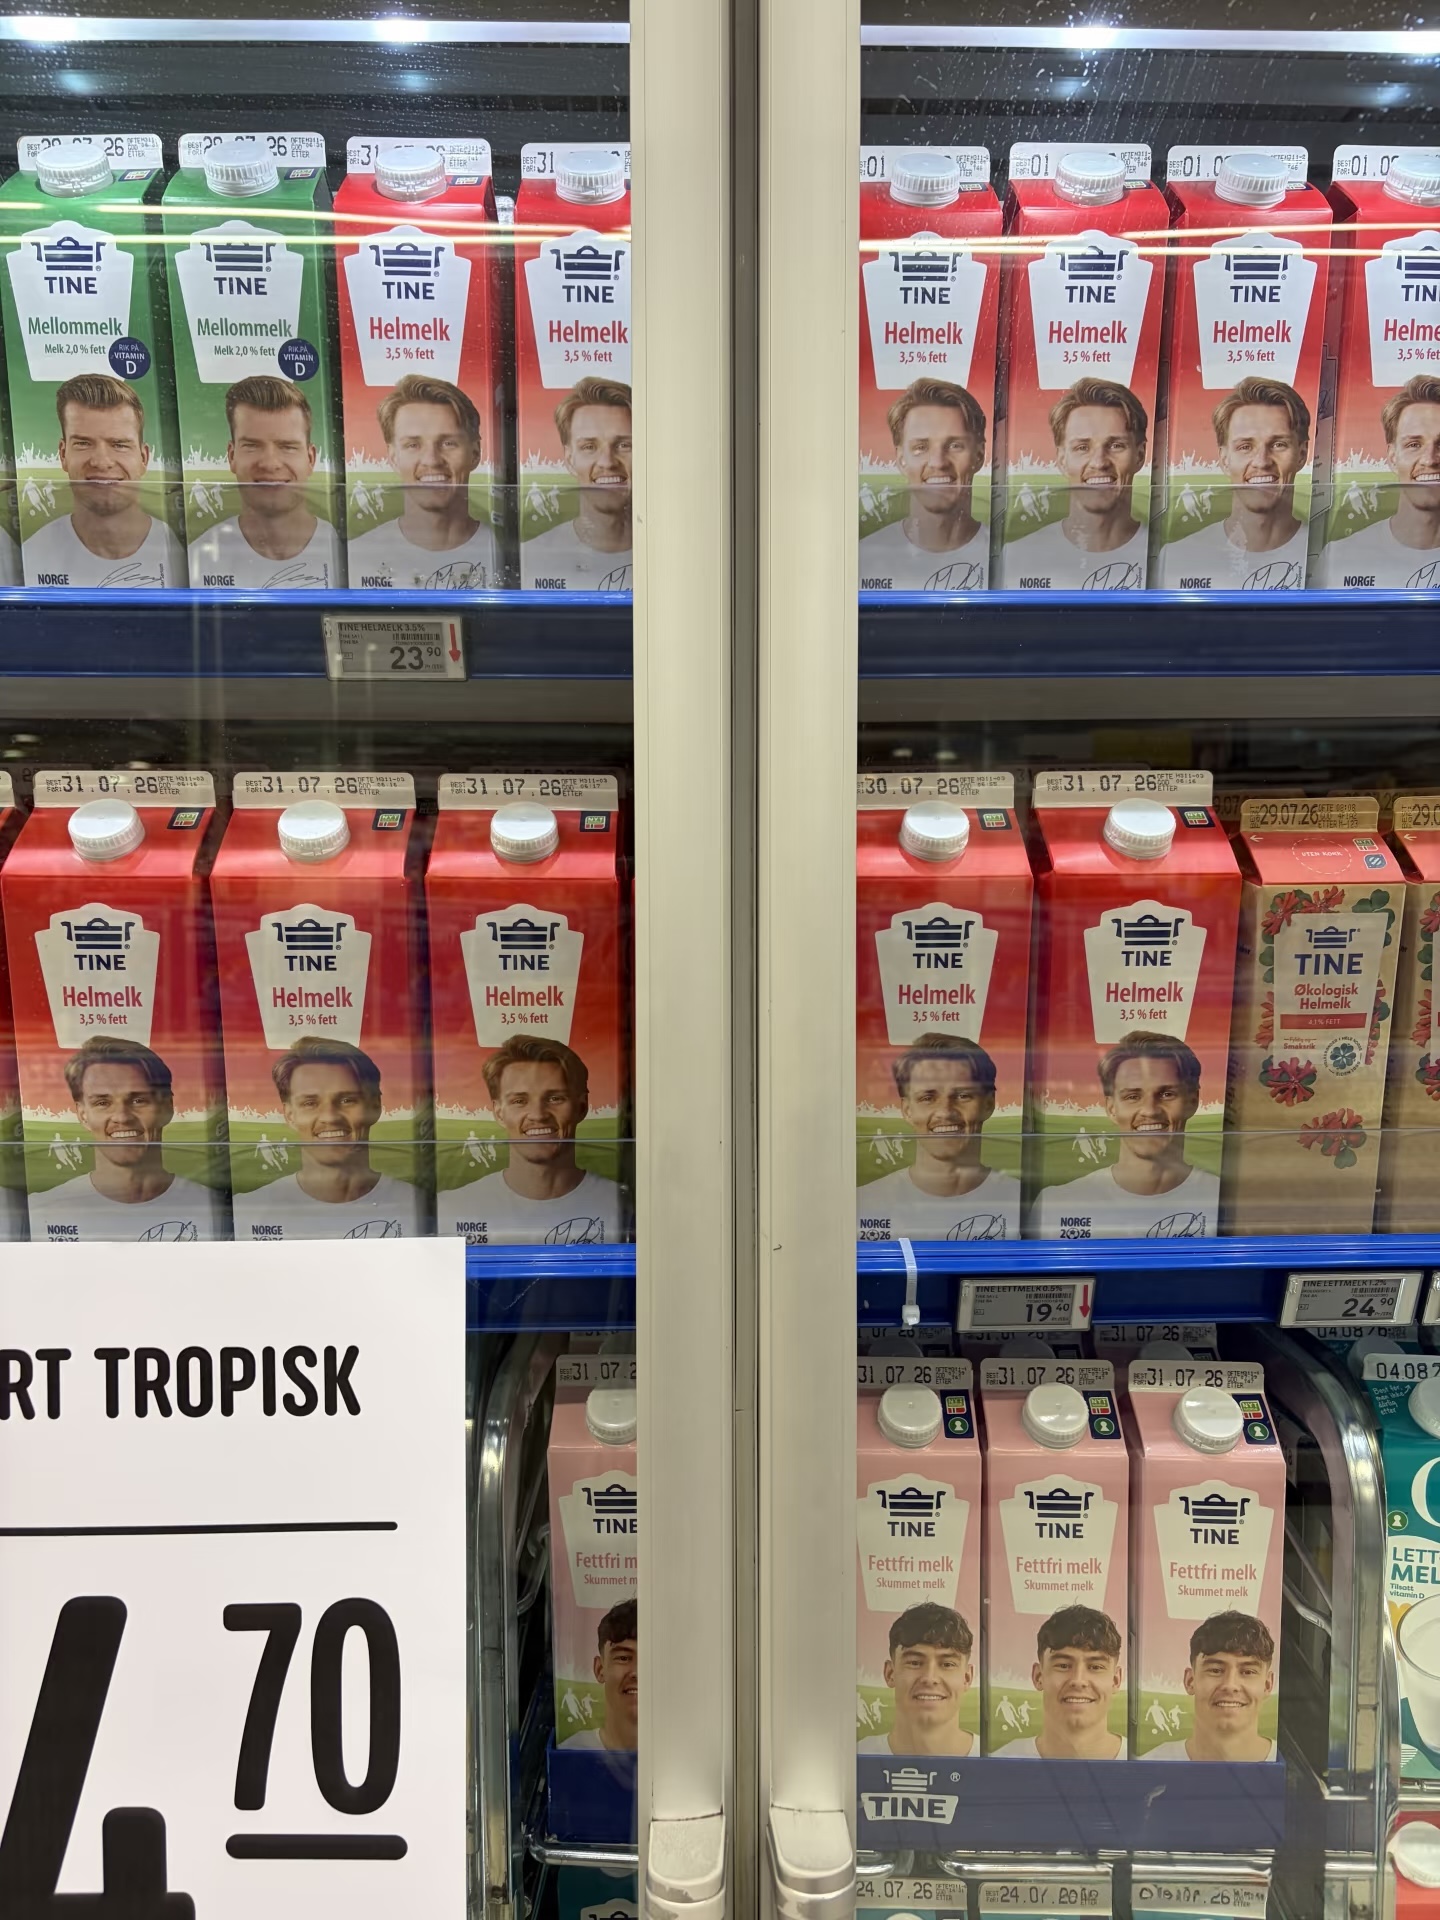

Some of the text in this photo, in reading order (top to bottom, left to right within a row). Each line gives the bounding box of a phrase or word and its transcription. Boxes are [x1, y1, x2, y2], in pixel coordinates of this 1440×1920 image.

[44, 276, 97, 294] TINE
[213, 277, 267, 295] TINE
[382, 281, 435, 300] TINE
[562, 285, 614, 303] TINE
[899, 287, 951, 304] TINE
[1065, 285, 1117, 303] TINE
[1230, 285, 1281, 303] TINE
[28, 317, 123, 335] Mellommelk
[197, 318, 292, 338] Mellommelk
[369, 317, 450, 341] Helmelk
[549, 320, 629, 344] Helmelk
[884, 321, 963, 345] Helmelk
[1048, 320, 1127, 343] Helmelk
[1213, 320, 1292, 343] Helmelk
[44, 344, 64, 354] Melk
[89, 343, 106, 354] fett
[118, 344, 131, 352] RIK
[214, 345, 234, 355] Melk
[259, 344, 275, 355] fett
[114, 353, 145, 361] VITAMIN
[283, 354, 314, 362] VITAMIN
[564, 350, 612, 363] 3,5 % fett
[1063, 350, 1111, 363] 3,5 % fett
[1227, 349, 1275, 362] 3,5 % fett
[126, 360, 137, 374] D
[295, 362, 306, 376] D
[38, 574, 69, 586] NORGE
[203, 575, 235, 587] NORGE
[535, 578, 566, 590] NORGE
[861, 578, 893, 589] NORGE
[1019, 578, 1051, 589] NORGE
[1180, 577, 1211, 589] NORGE
[1343, 575, 1375, 587] NORGE
[361, 623, 403, 632] HELMELK
[389, 646, 441, 671] 23 90
[1260, 803, 1319, 826] 29.07.26
[74, 954, 126, 971] TINE
[284, 955, 337, 971] TINE
[499, 954, 550, 971] TINE
[913, 953, 963, 969] TINE
[1121, 950, 1172, 967] TINE
[1294, 953, 1364, 976] TINE
[62, 986, 143, 1007] Helmelk
[486, 985, 564, 1007] Helmelk
[898, 984, 976, 1005] Helmelk
[1105, 981, 1184, 1003] Helmelk
[1294, 982, 1359, 998] Økologisk
[272, 987, 353, 1008] Helmelk
[1299, 997, 1352, 1010] Helmelk
[79, 1013, 127, 1026] 3,5 % fett
[288, 1014, 337, 1027] 3,5 % fett
[501, 1012, 549, 1025] 3,5 % fett
[913, 1010, 960, 1022] 3,5 % fett
[1120, 1008, 1167, 1021] 3,5 % fett
[456, 1221, 488, 1232] NORGE
[860, 1218, 891, 1229] NORGE
[1060, 1217, 1091, 1227] NORGE
[47, 1224, 79, 1235] NORGE
[252, 1224, 283, 1235] NORGE
[997, 1285, 1041, 1293] LETTMELK
[1025, 1303, 1070, 1323] 19 40
[1342, 1297, 1394, 1317] 24 90
[94, 1345, 362, 1419] TROPISK
[1372, 1387, 1388, 1395] Best
[1242, 1402, 1258, 1410] NYT
[1378, 1399, 1398, 1408] dårlig
[1380, 1407, 1397, 1415] etter
[887, 1522, 935, 1537] TINE
[1035, 1523, 1084, 1539] TINE
[1190, 1528, 1239, 1545] TINE
[575, 1552, 620, 1569] Fettfri
[868, 1555, 953, 1572] Fettfri melk
[1016, 1556, 1102, 1575] Fettfri melk
[1169, 1562, 1257, 1581] Fettfri melk
[584, 1573, 627, 1586] Skummet
[876, 1577, 945, 1589] Skummet melk
[1024, 1579, 1094, 1592] Skummet melk
[1178, 1584, 1248, 1597] Skummet melk
[1390, 1583, 1414, 1591] Tilsatt
[1389, 1590, 1418, 1599] vitamin
[223, 1597, 401, 1815] 70
[868, 1796, 947, 1819] TINE
